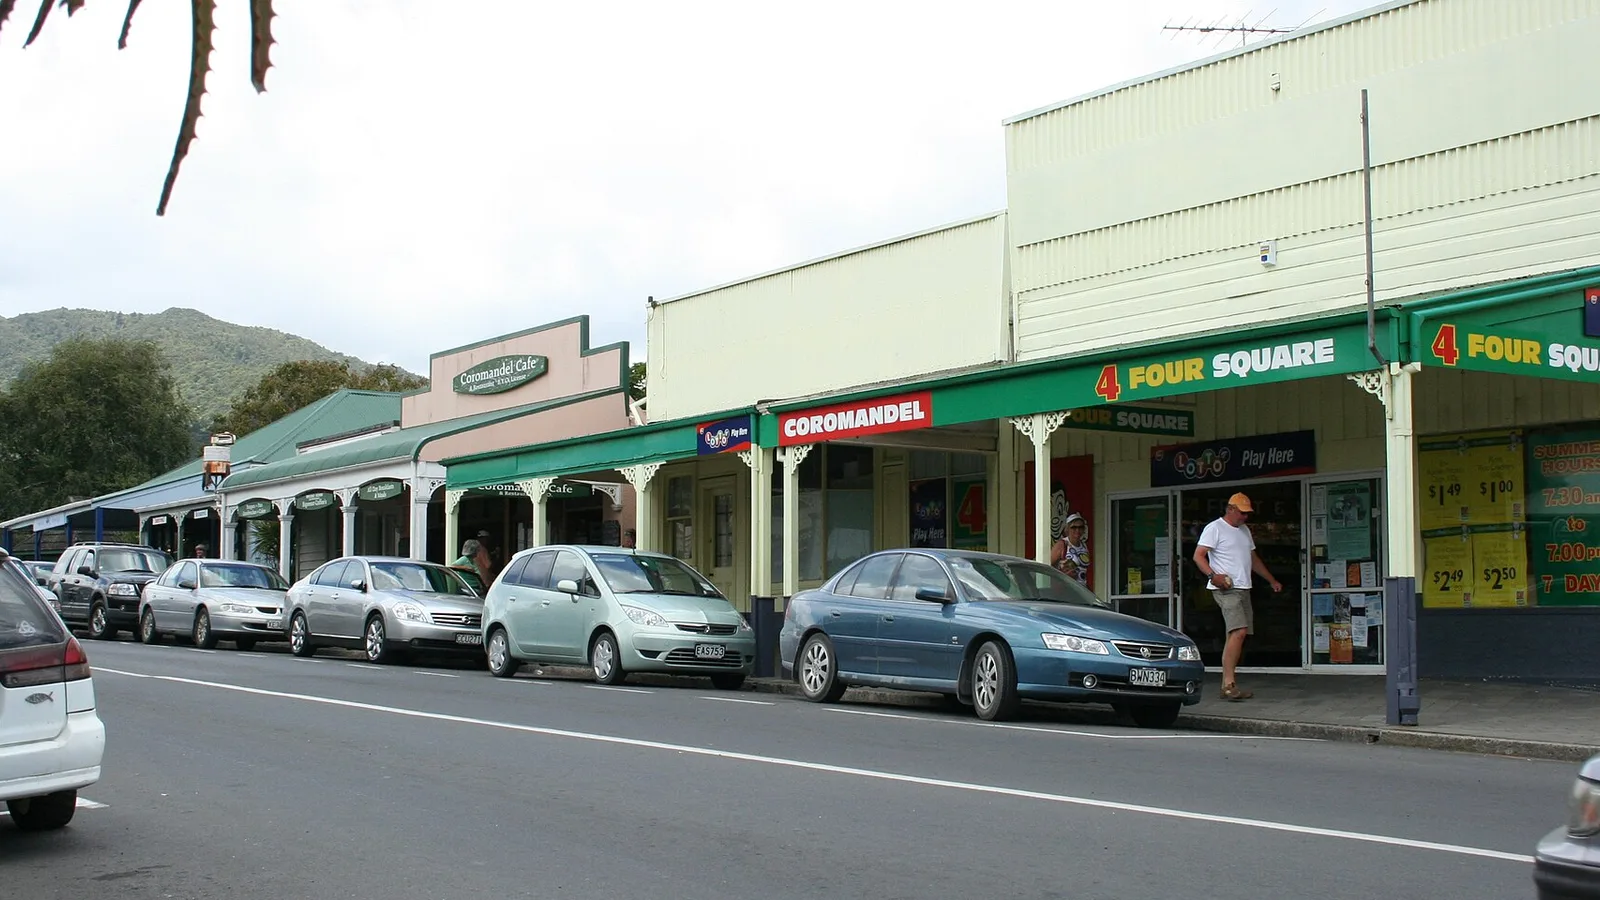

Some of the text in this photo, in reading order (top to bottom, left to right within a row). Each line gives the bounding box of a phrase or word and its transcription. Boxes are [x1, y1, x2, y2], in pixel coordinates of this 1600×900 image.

[1431, 323, 1600, 373] 4 FOUR SQU
[460, 356, 537, 386] Coromandel Cafe
[1094, 337, 1334, 402] 4 FOUR SQUARE
[784, 401, 925, 437] COROMANDEL
[1068, 409, 1188, 431] OUR SQUARE
[1534, 441, 1600, 459] SUMME
[1175, 447, 1294, 478] LOTTO Play Here
[549, 484, 573, 494] Cafe
[957, 483, 987, 535] 4
[1566, 516, 1586, 532] to
[913, 527, 945, 542] Play Here
[1541, 574, 1600, 593] 7 DAY
[696, 646, 724, 656] EAS753
[1130, 669, 1165, 683] BWN334
